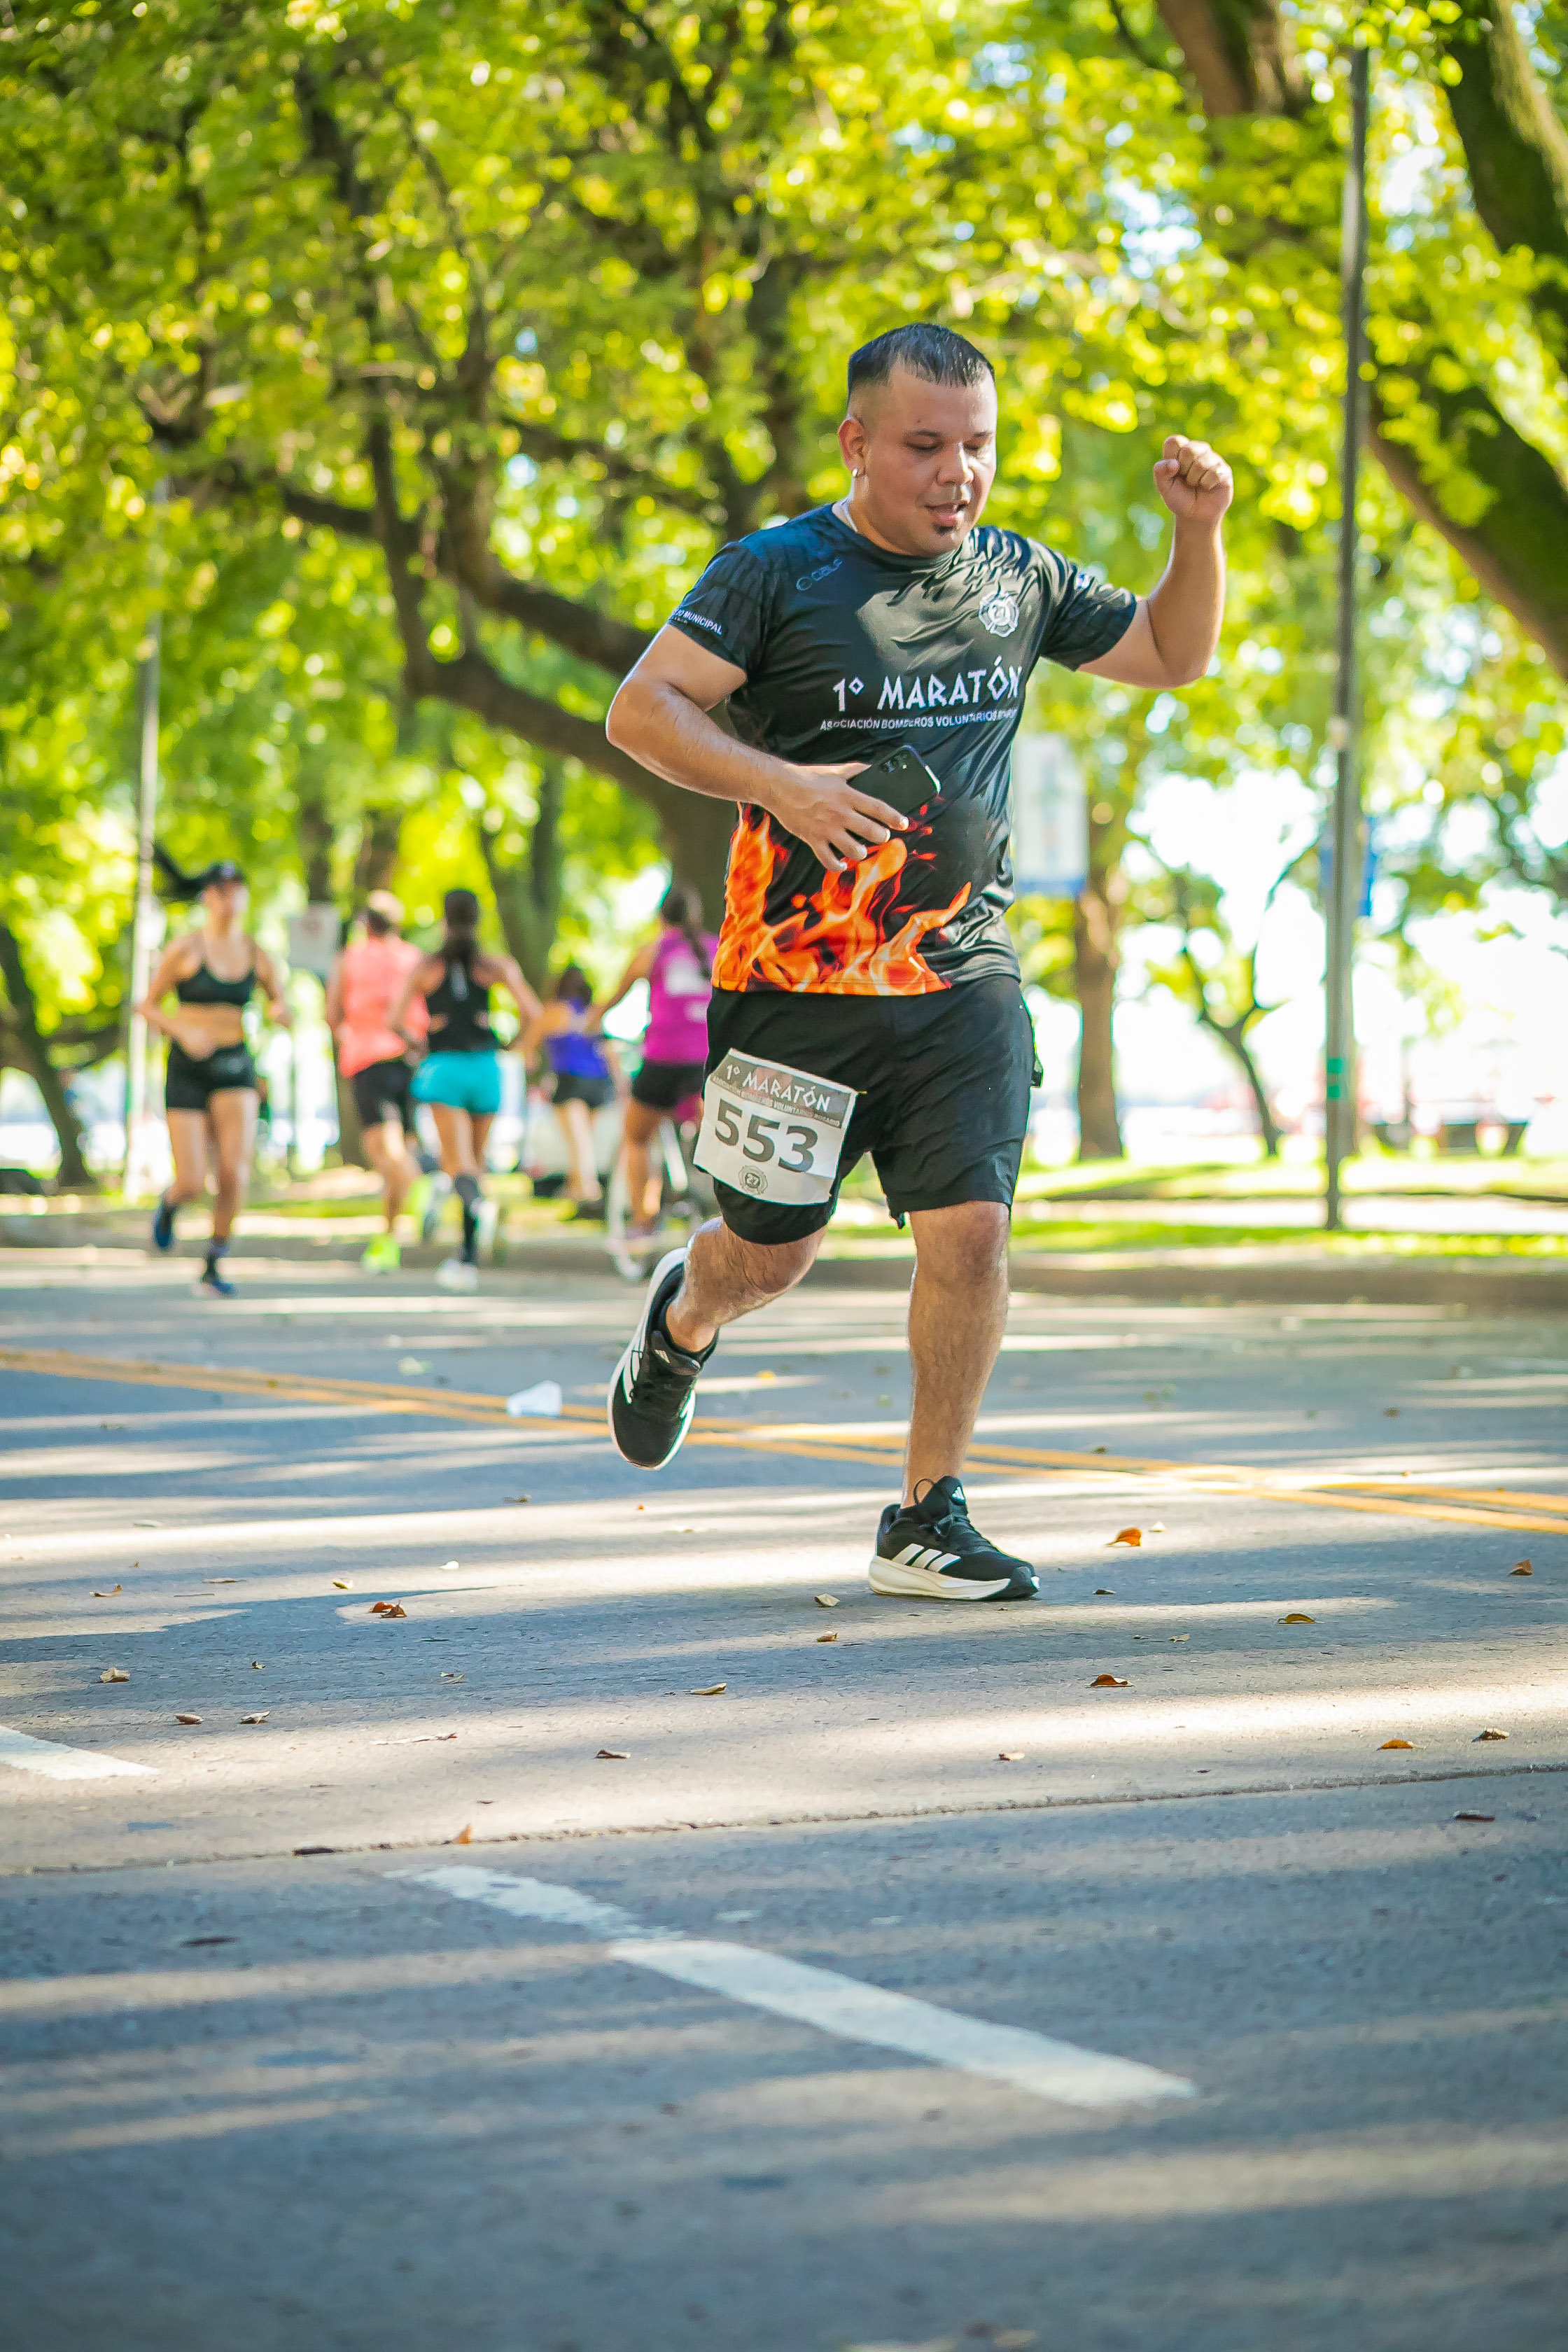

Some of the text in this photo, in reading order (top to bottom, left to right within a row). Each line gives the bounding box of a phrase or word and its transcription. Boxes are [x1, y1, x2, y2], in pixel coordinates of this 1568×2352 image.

[683, 610, 723, 636] MUNICIPAL
[876, 654, 1022, 710] MARATÓN
[742, 1071, 831, 1113] MARATÓN
[715, 1098, 818, 1173] 553
